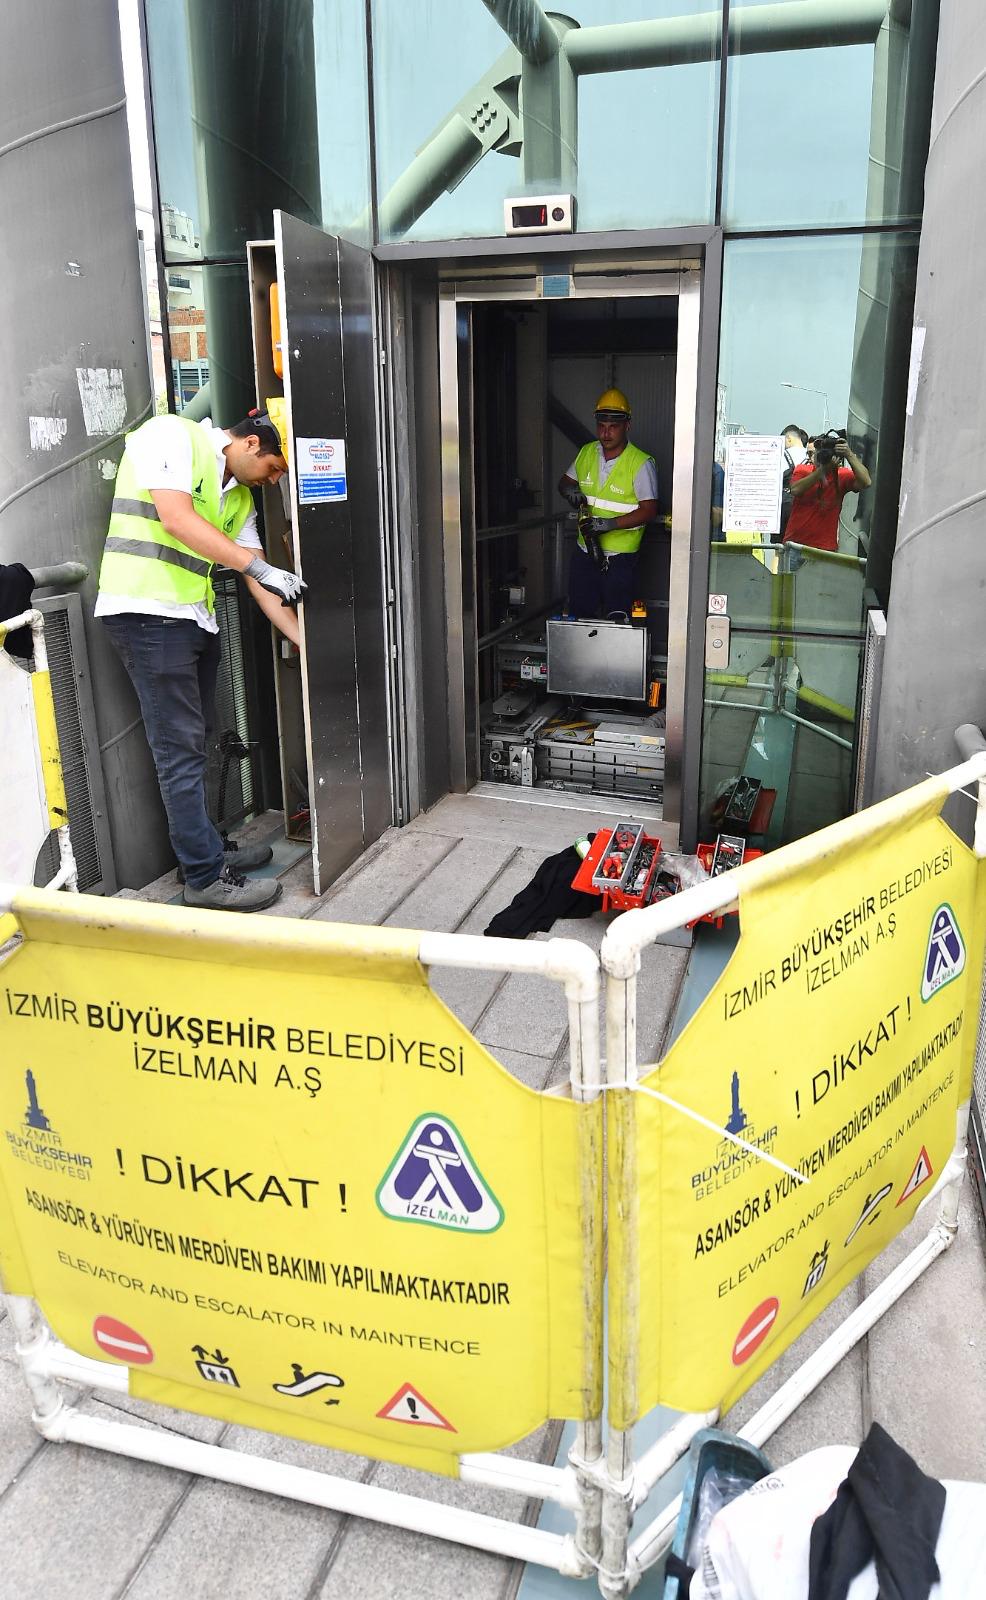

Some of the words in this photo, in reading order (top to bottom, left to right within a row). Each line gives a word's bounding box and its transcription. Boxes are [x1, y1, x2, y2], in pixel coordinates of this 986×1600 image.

[724, 967, 777, 1021] İZMİR
[782, 896, 876, 983] BÜYÜKŞEHİR
[879, 845, 953, 909] BELEDİYESİ
[805, 931, 870, 995] İZELMAN
[875, 912, 898, 944] A.Ş
[5, 988, 80, 1025] İZMİR
[86, 1000, 277, 1051] BÜYÜKŞEHİR
[286, 1026, 465, 1077] BELEDİYESİ
[133, 1041, 258, 1086] İZELMAN
[274, 1063, 323, 1099] A.Ş
[795, 1089, 801, 1120] !
[812, 1005, 900, 1106] DİKKAT
[116, 1148, 126, 1177] !
[141, 1154, 320, 1209] DİKKAT
[338, 1183, 347, 1213] !
[406, 1202, 470, 1226] İZELMAN
[694, 1196, 760, 1260] ASANSÖR
[763, 1188, 772, 1213] &
[775, 1144, 826, 1204] YÜRÜYEN
[827, 1100, 874, 1162] MERDİVEN
[874, 1073, 903, 1118] BAKIMI
[717, 1227, 796, 1299] ELEVATOR
[797, 1201, 825, 1236] AND
[827, 1136, 894, 1208] ESCALATOR
[894, 1127, 905, 1145] IN
[906, 1070, 954, 1132] MAINTENCE
[25, 1187, 89, 1231] ASANSÖR
[90, 1212, 102, 1234] &
[101, 1213, 176, 1255] YÜRÜYEN
[178, 1234, 263, 1273] MERDİVEN
[266, 1252, 327, 1285] BAKIMI
[330, 1263, 511, 1305] YAPILMAKTAKTADIR
[57, 1250, 146, 1294] ELEVATOR
[149, 1284, 189, 1305] AND
[194, 1294, 317, 1332] ESCALATOR
[322, 1320, 343, 1337] IN
[349, 1325, 481, 1356] MAINTENCE
